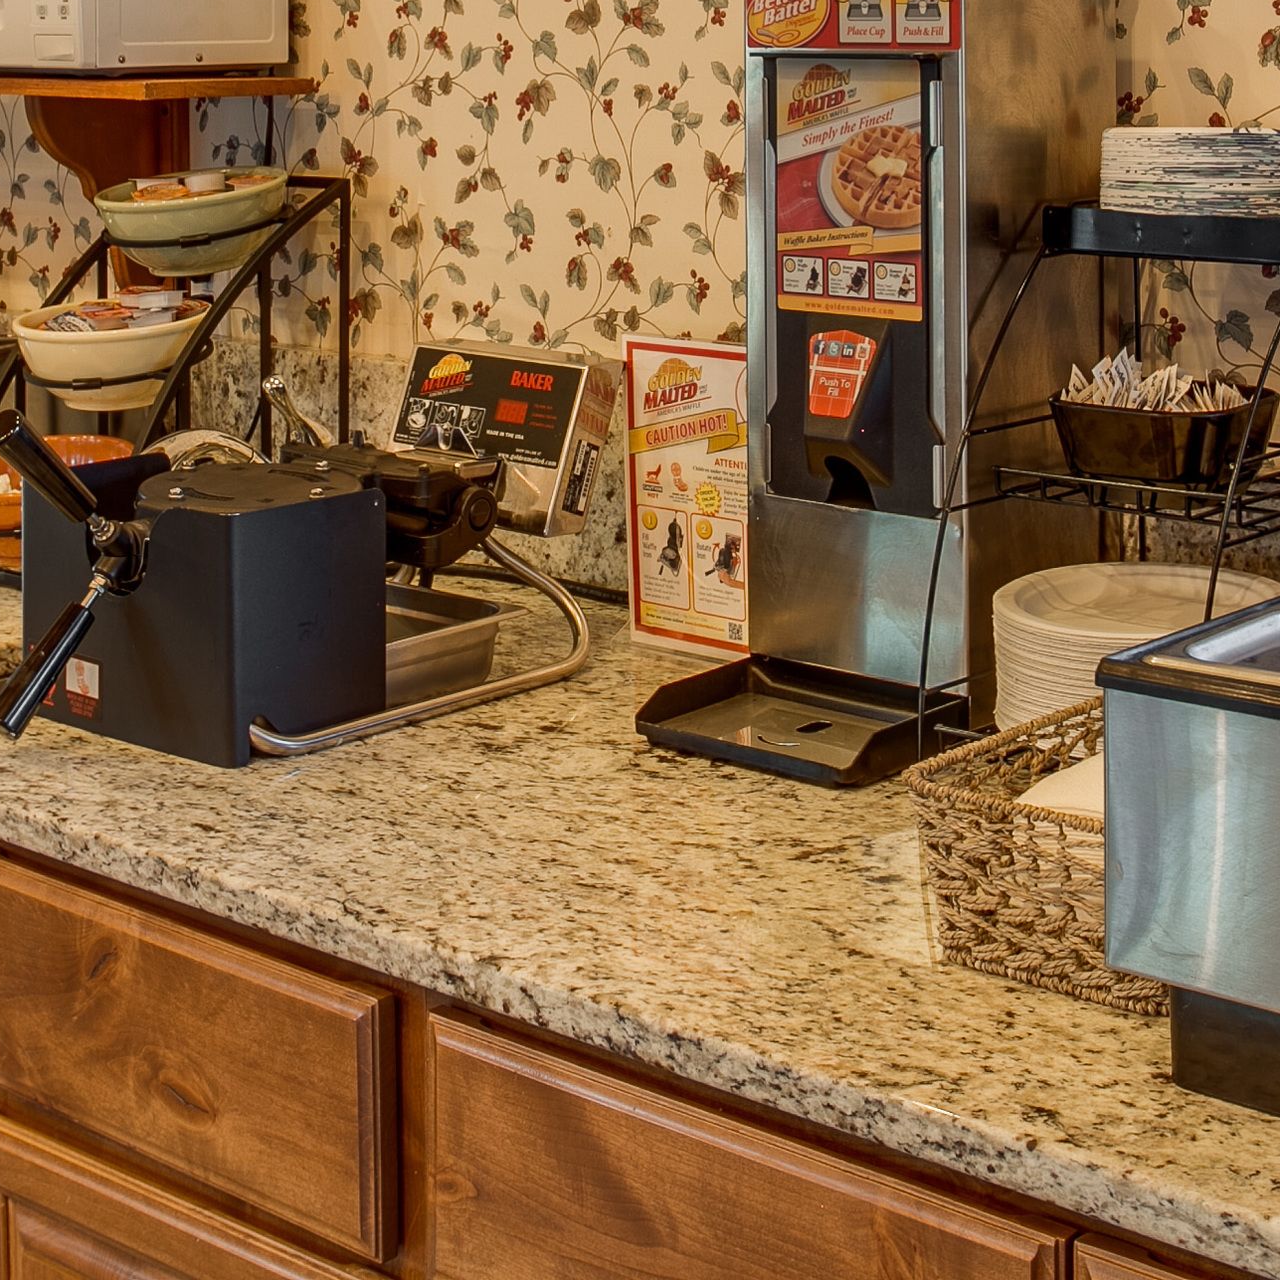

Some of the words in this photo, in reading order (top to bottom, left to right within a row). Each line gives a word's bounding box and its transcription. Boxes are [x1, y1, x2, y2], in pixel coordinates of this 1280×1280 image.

[846, 26, 868, 36] Place
[869, 26, 886, 39] Cup
[903, 26, 921, 36] Push
[923, 27, 930, 36] &
[930, 26, 944, 36] Fill
[792, 68, 851, 102] GOLDEN
[787, 89, 846, 122] MALTED
[801, 126, 838, 147] Simply
[840, 121, 857, 134] the
[858, 107, 894, 129] Finest!
[783, 235, 806, 246] Waffle
[806, 233, 827, 244] Baker
[827, 231, 869, 241] Instructions
[510, 370, 554, 392] BAKER
[648, 365, 703, 393] GOLDEN
[819, 376, 839, 387] Push
[840, 379, 851, 388] To
[643, 382, 698, 410] MALTED
[827, 387, 840, 397] Fill
[645, 421, 696, 445] CAUTION
[699, 413, 727, 435] HOT!
[714, 457, 747, 471] ATTENTI
